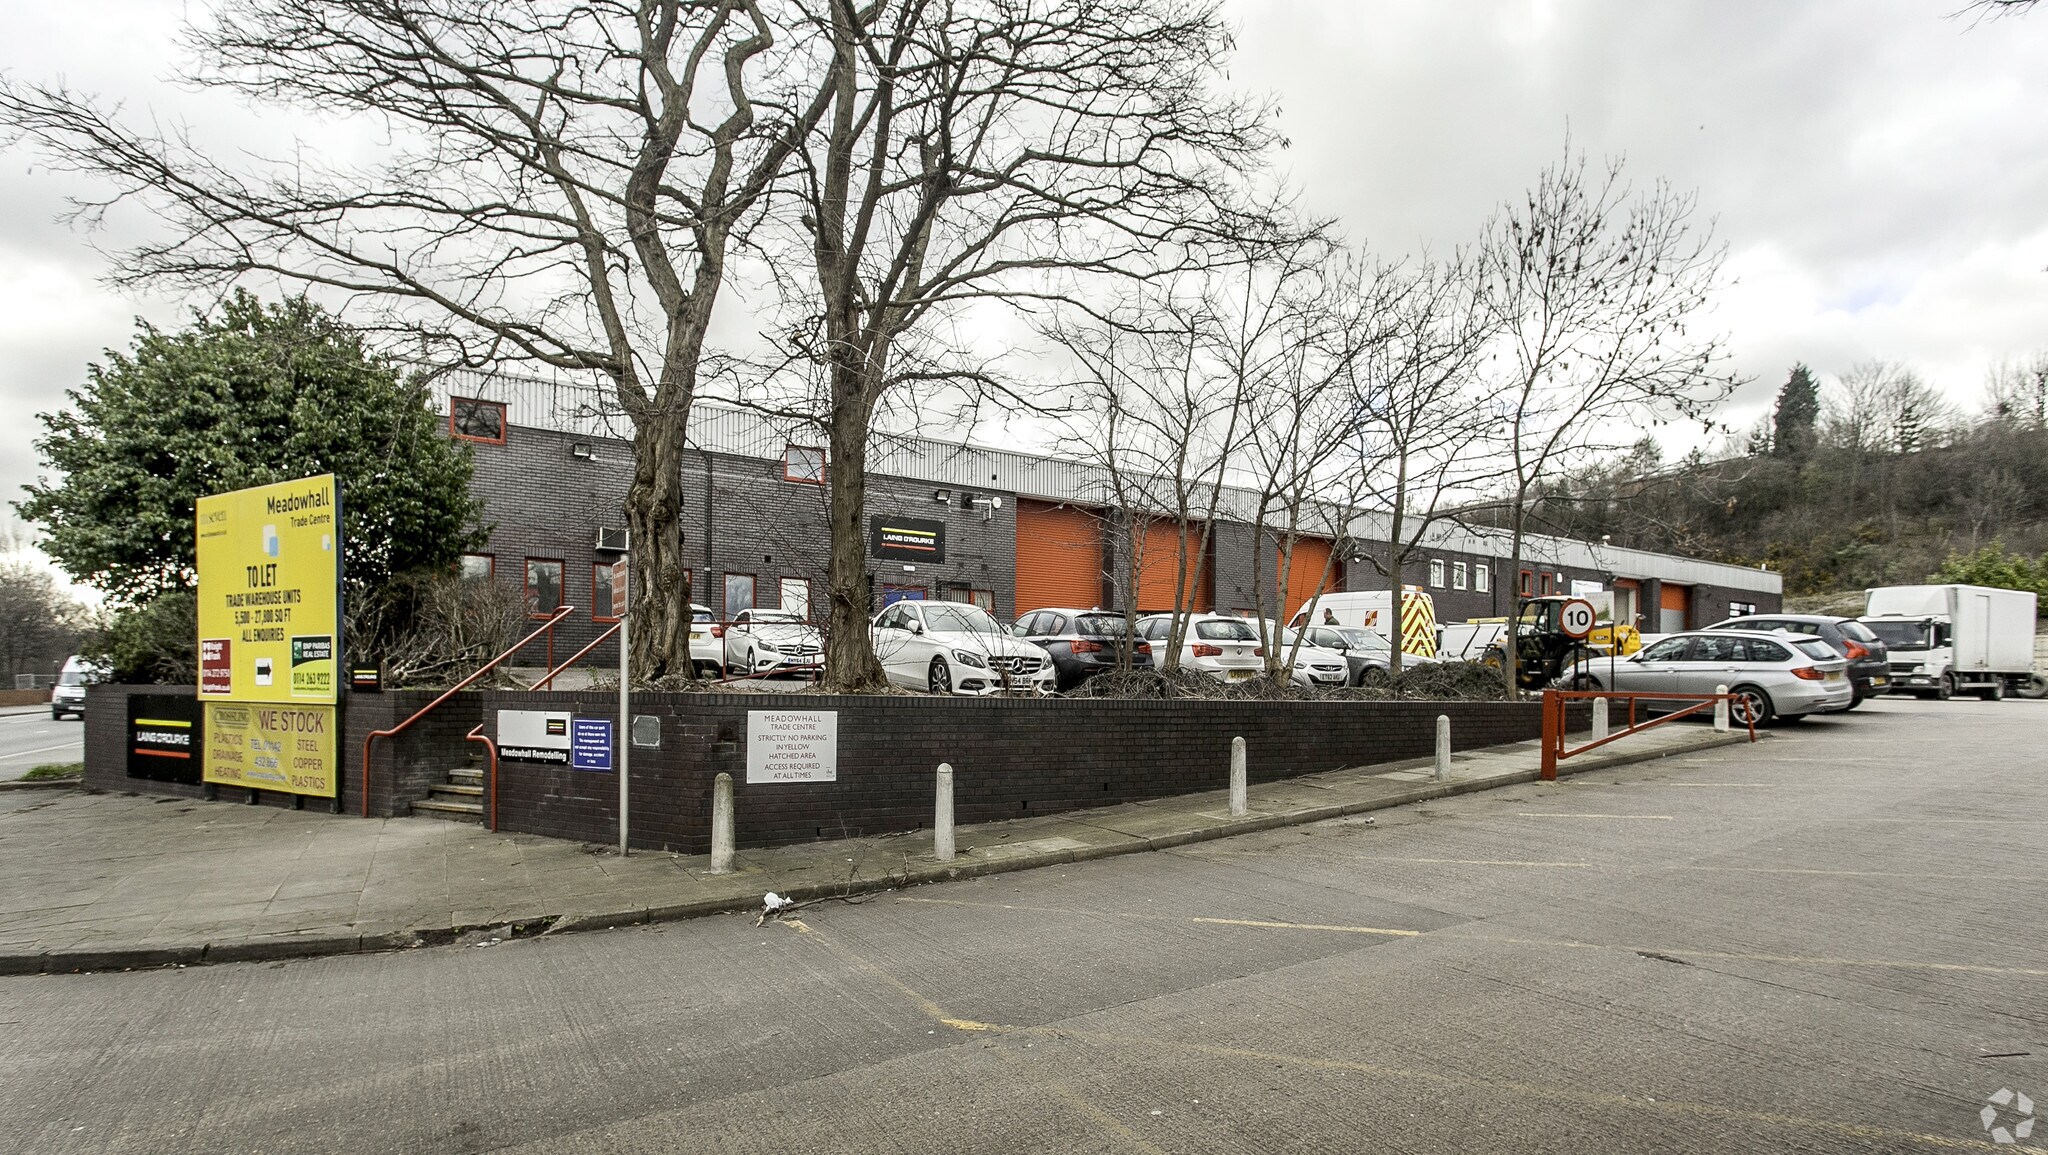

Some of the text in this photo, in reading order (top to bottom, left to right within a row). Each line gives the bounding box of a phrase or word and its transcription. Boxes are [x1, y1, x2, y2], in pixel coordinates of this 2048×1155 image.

[267, 486, 329, 514] Meadowhall
[290, 513, 330, 527] Trade Centre
[247, 563, 277, 588] TO LET
[226, 589, 301, 607] TRADE WAREHOUSE UNITS
[284, 608, 291, 622] FT
[1568, 610, 1588, 626] 10
[242, 627, 284, 642] ALL ENQUIRIES
[314, 650, 329, 658] ESTATE
[294, 672, 330, 684] 0114 263 9222
[259, 710, 324, 734] WE STOCK
[214, 732, 243, 745] PLASTICS
[297, 738, 319, 752] STEEL
[501, 748, 566, 762] Meadowhall Remodelling
[293, 756, 323, 770] COPPER
[215, 766, 241, 780] HEATING
[292, 774, 325, 790] PLASTICS
